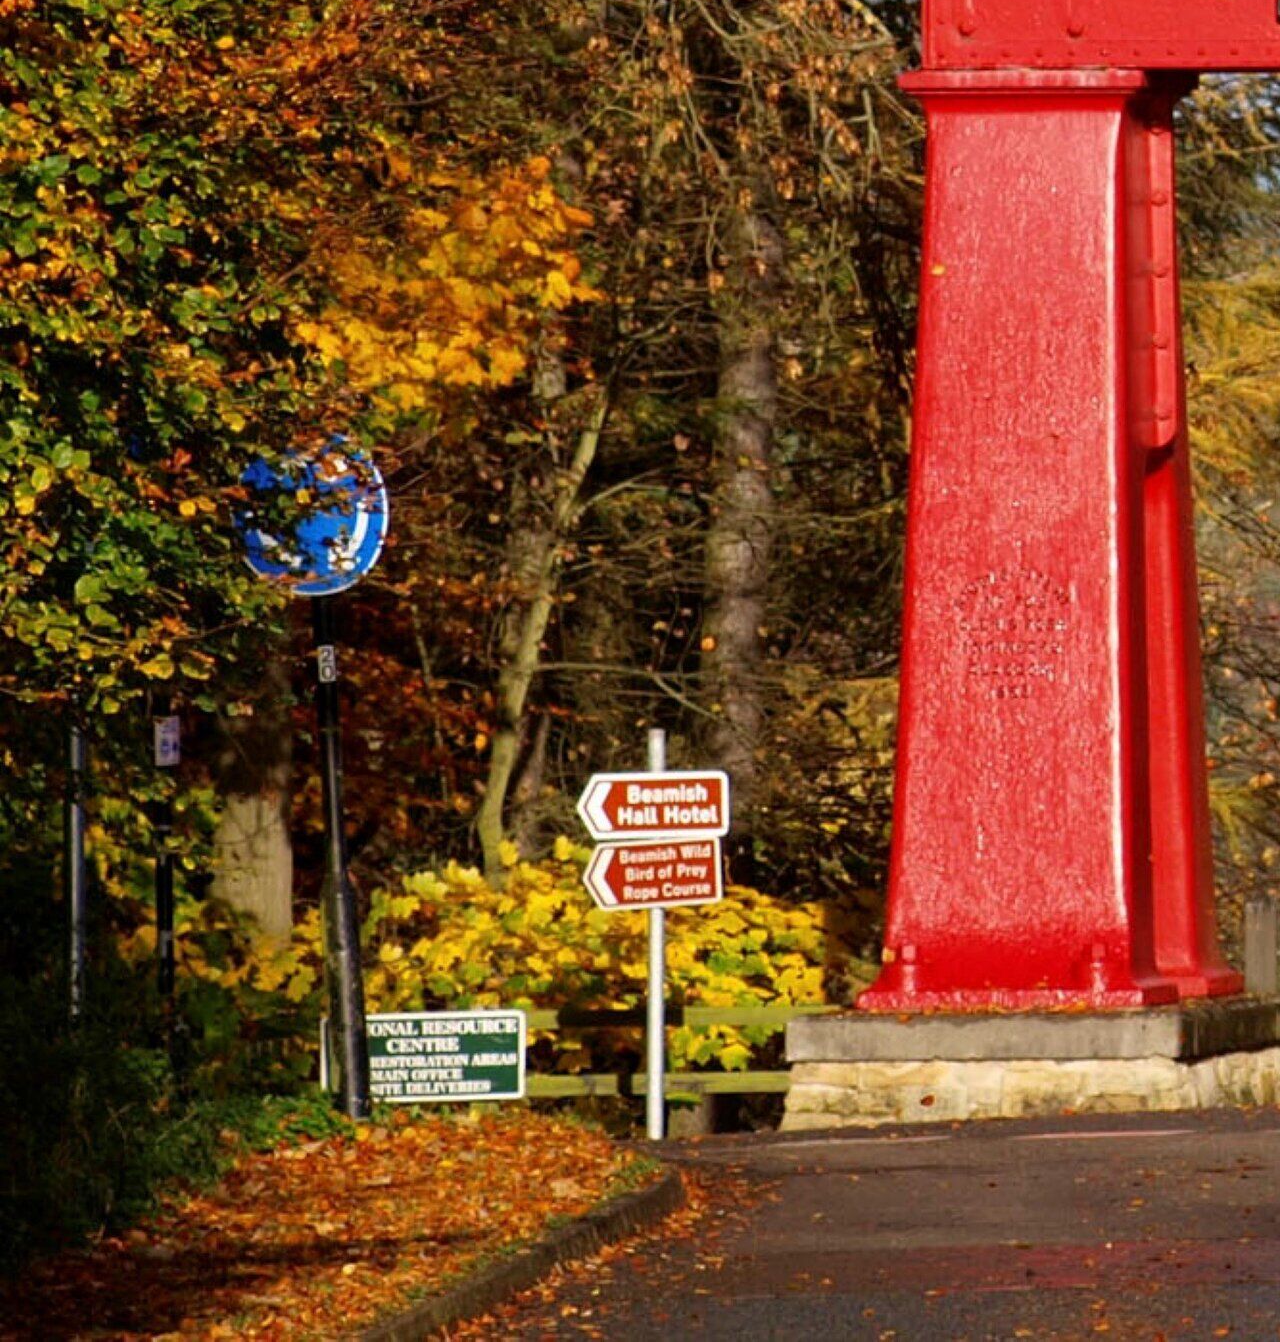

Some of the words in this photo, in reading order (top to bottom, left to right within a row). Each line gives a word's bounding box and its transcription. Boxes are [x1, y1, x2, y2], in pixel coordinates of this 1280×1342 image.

[626, 783, 708, 805] Beamish
[617, 806, 659, 826] Hall
[662, 805, 719, 824] Hotel
[619, 847, 677, 864] Beamish
[679, 844, 711, 858] Wild
[625, 866, 655, 881] Bird
[657, 864, 673, 879] of
[676, 864, 707, 879] Prey
[623, 886, 659, 901] Rope
[662, 883, 711, 897] Course
[421, 1018, 518, 1035] RESOURCE
[385, 1037, 460, 1054] CENTRE
[369, 1069, 409, 1083] MAIN
[411, 1067, 463, 1082] OFFICE
